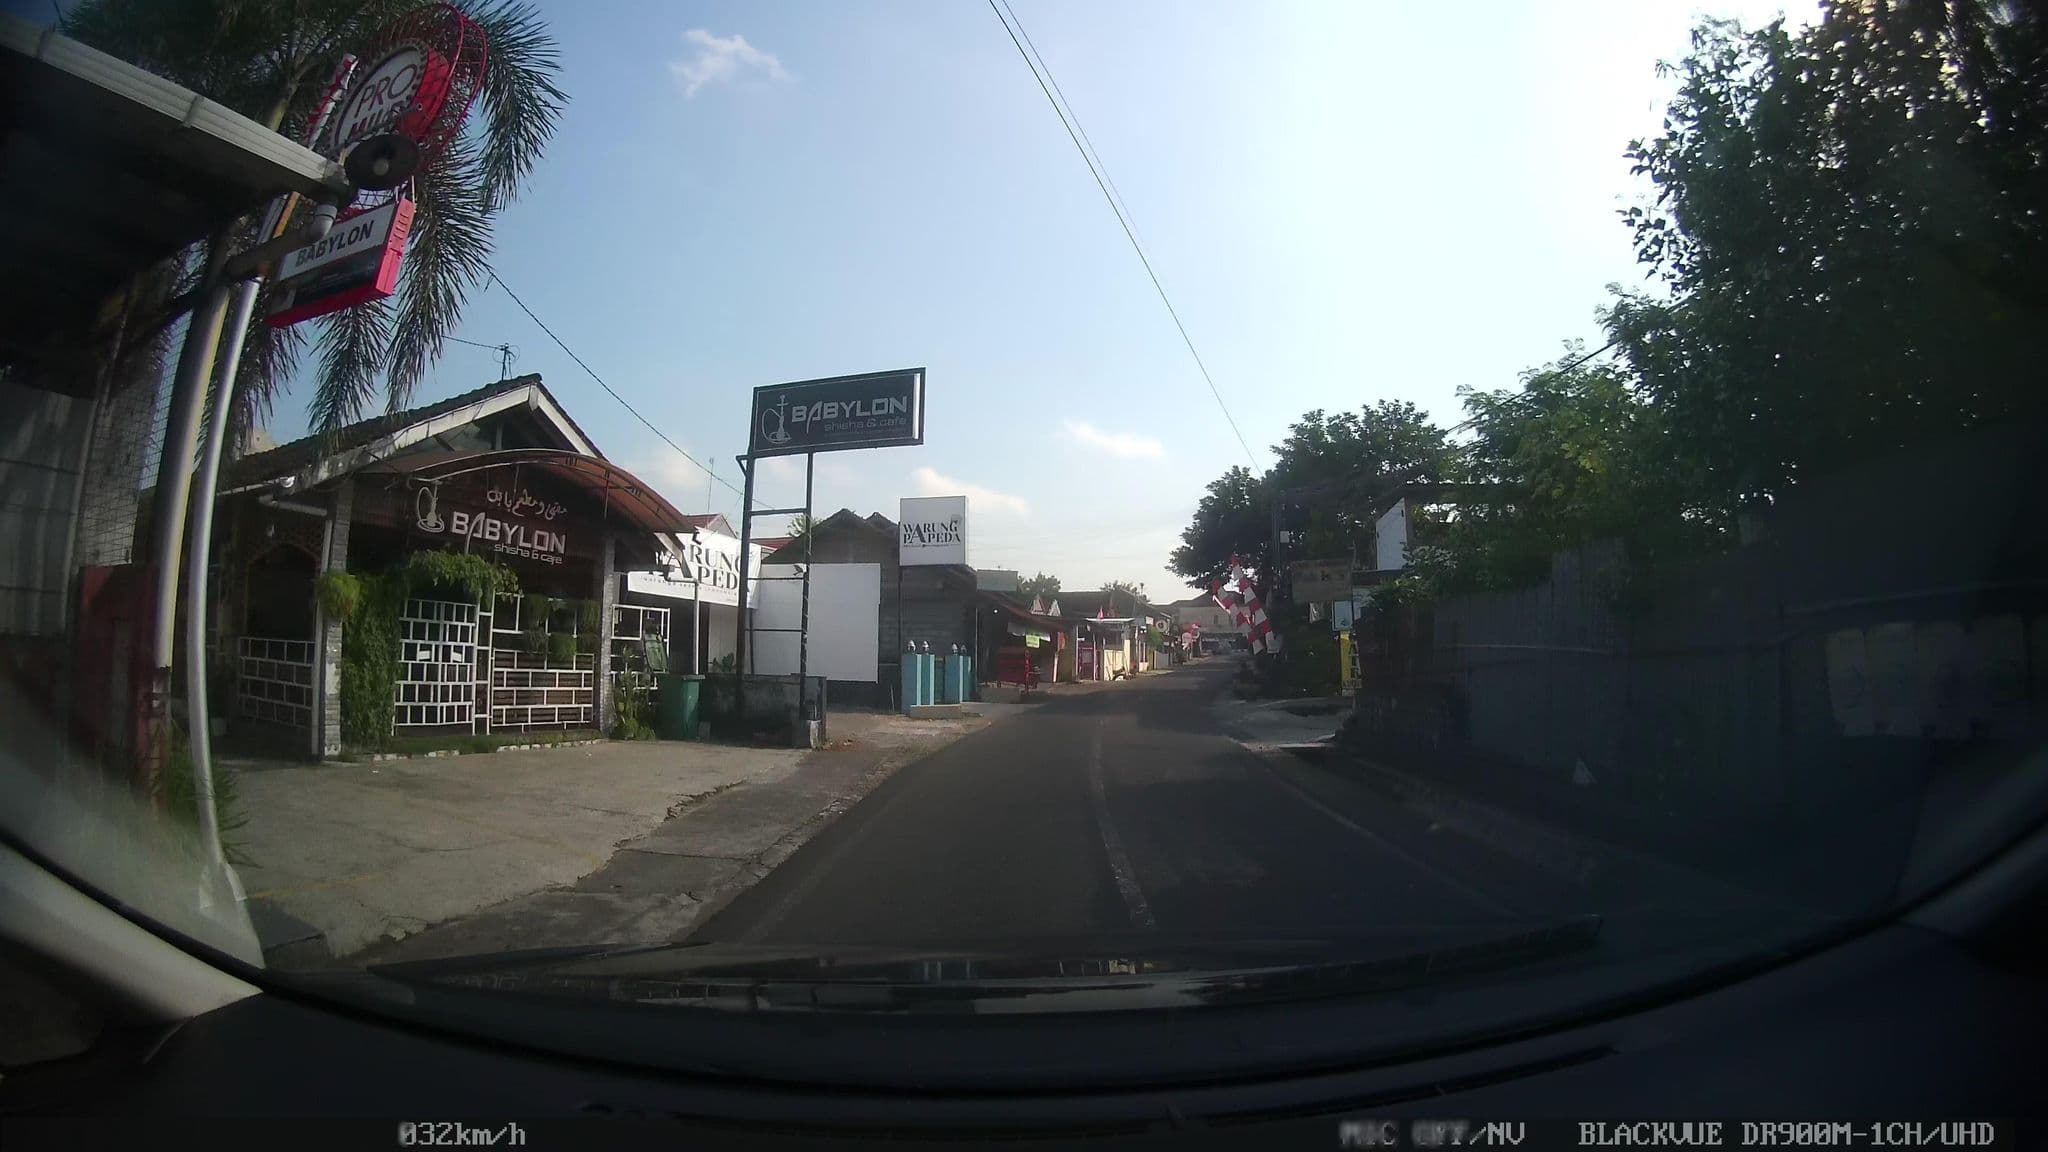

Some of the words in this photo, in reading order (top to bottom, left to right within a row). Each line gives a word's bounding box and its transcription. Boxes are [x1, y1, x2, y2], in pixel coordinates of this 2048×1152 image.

[355, 64, 417, 118] PRO
[296, 220, 375, 267] BABYLON
[792, 396, 907, 434] BABYLON
[452, 511, 567, 555] BABYLON
[903, 520, 958, 533] WARUNG
[903, 532, 961, 544] PAPEDA
[494, 542, 530, 558] shisha
